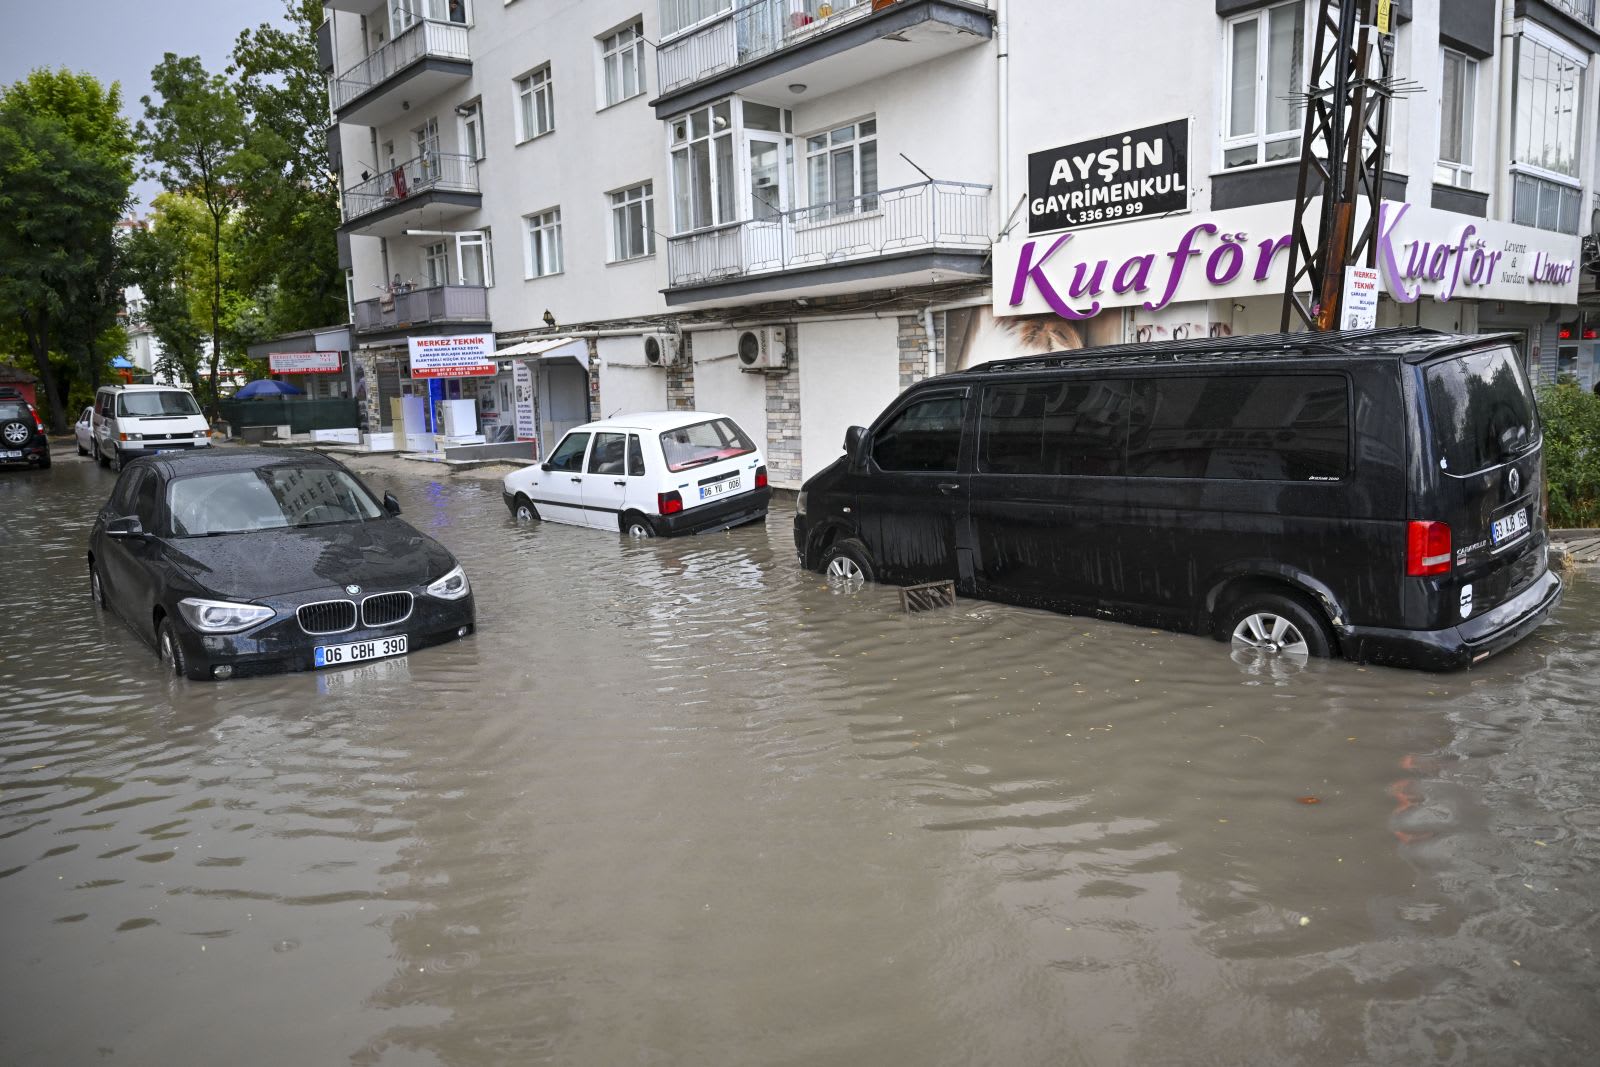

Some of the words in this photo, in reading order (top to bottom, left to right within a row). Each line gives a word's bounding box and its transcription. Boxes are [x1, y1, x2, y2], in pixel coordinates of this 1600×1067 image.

[1049, 135, 1163, 185] AYŞİN
[1031, 172, 1186, 216] GAYRİMENKUL
[1079, 208, 1102, 223] 336
[1105, 205, 1123, 219] 99
[1125, 201, 1144, 215] 99
[1376, 202, 1503, 304] Kuaför
[1504, 240, 1527, 254] Levent
[1511, 257, 1517, 268] &
[1008, 222, 1293, 320] Kuaför
[1353, 270, 1377, 280] MERKEZ
[1500, 271, 1525, 285] Nurdan
[1353, 281, 1375, 290] TEKNİK
[417, 339, 451, 347] MERKEZ
[453, 336, 484, 345] TEKNİK
[704, 487, 712, 496] 06
[1494, 521, 1503, 539] 63
[325, 647, 342, 663] 06
[351, 643, 375, 660] CBH
[383, 638, 405, 655] 390
